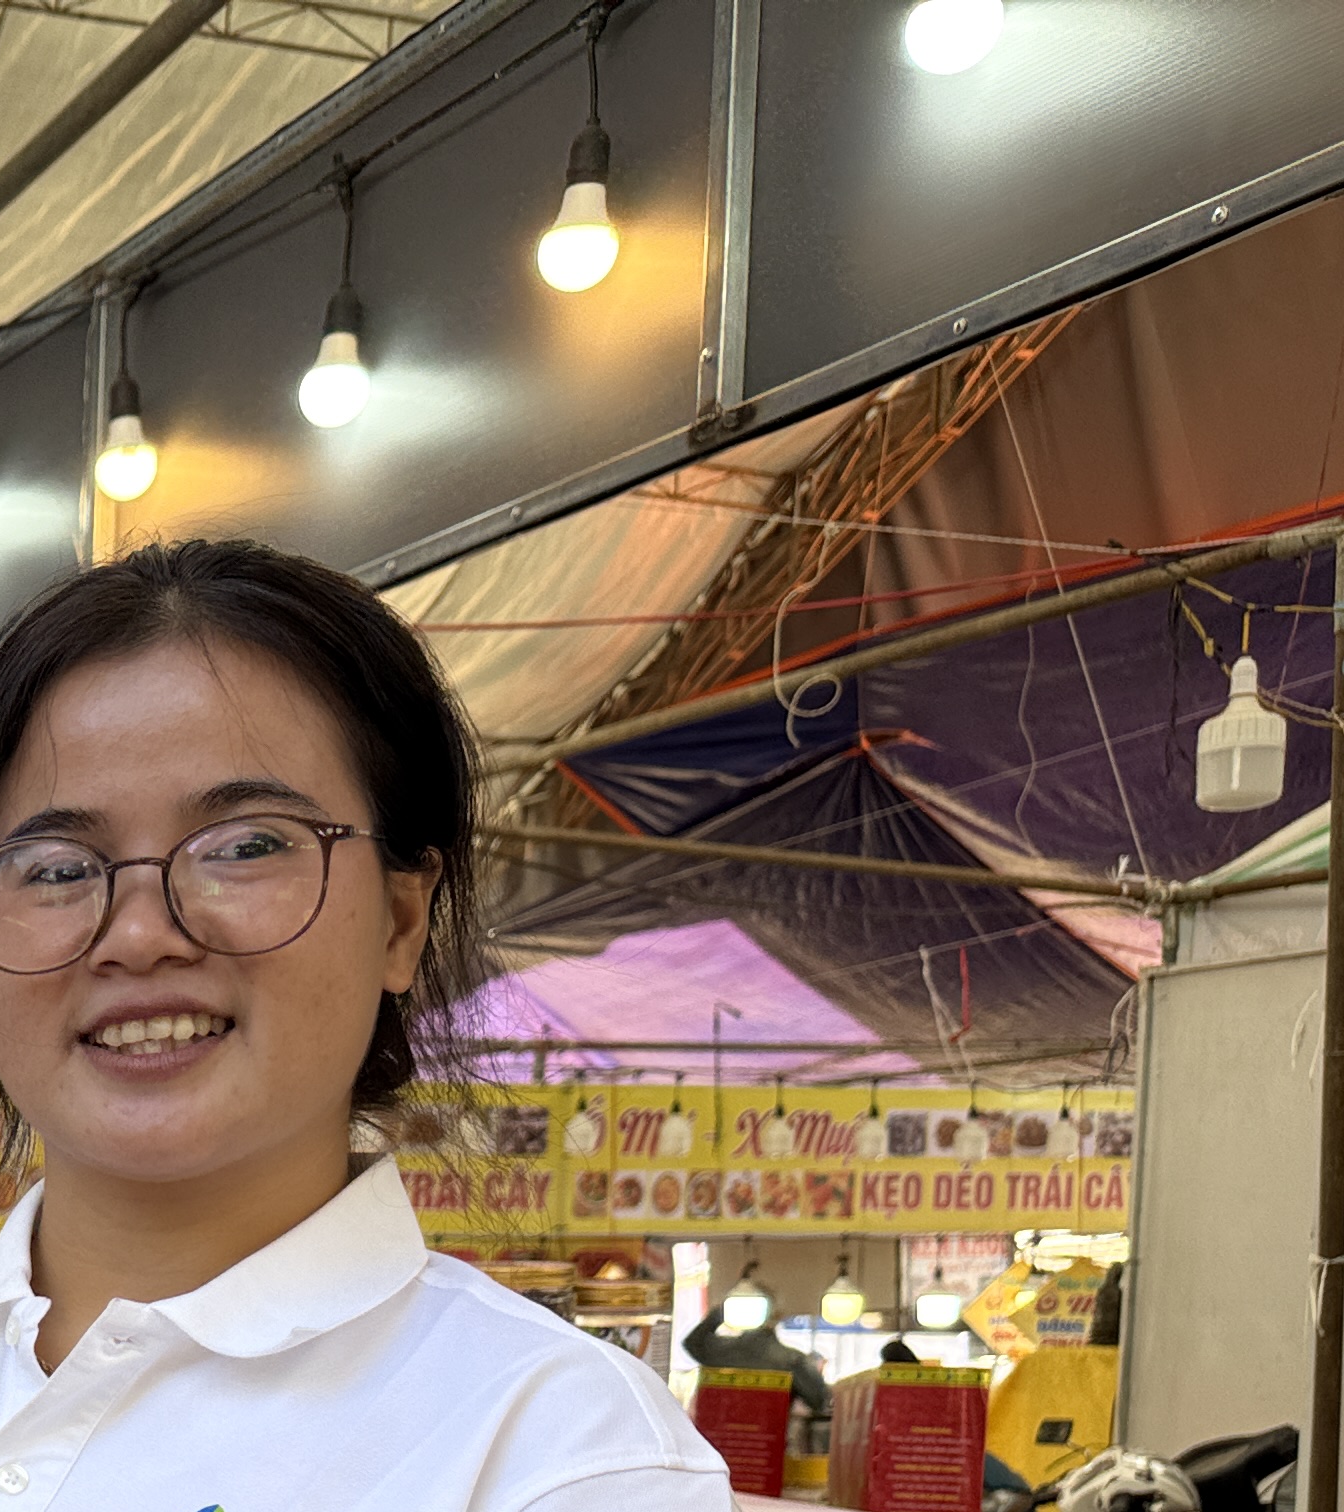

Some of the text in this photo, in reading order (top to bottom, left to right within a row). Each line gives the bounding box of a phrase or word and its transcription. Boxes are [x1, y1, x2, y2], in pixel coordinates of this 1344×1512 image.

[860, 1160, 1131, 1218] KẸO DẺO TRÁI CÂ
